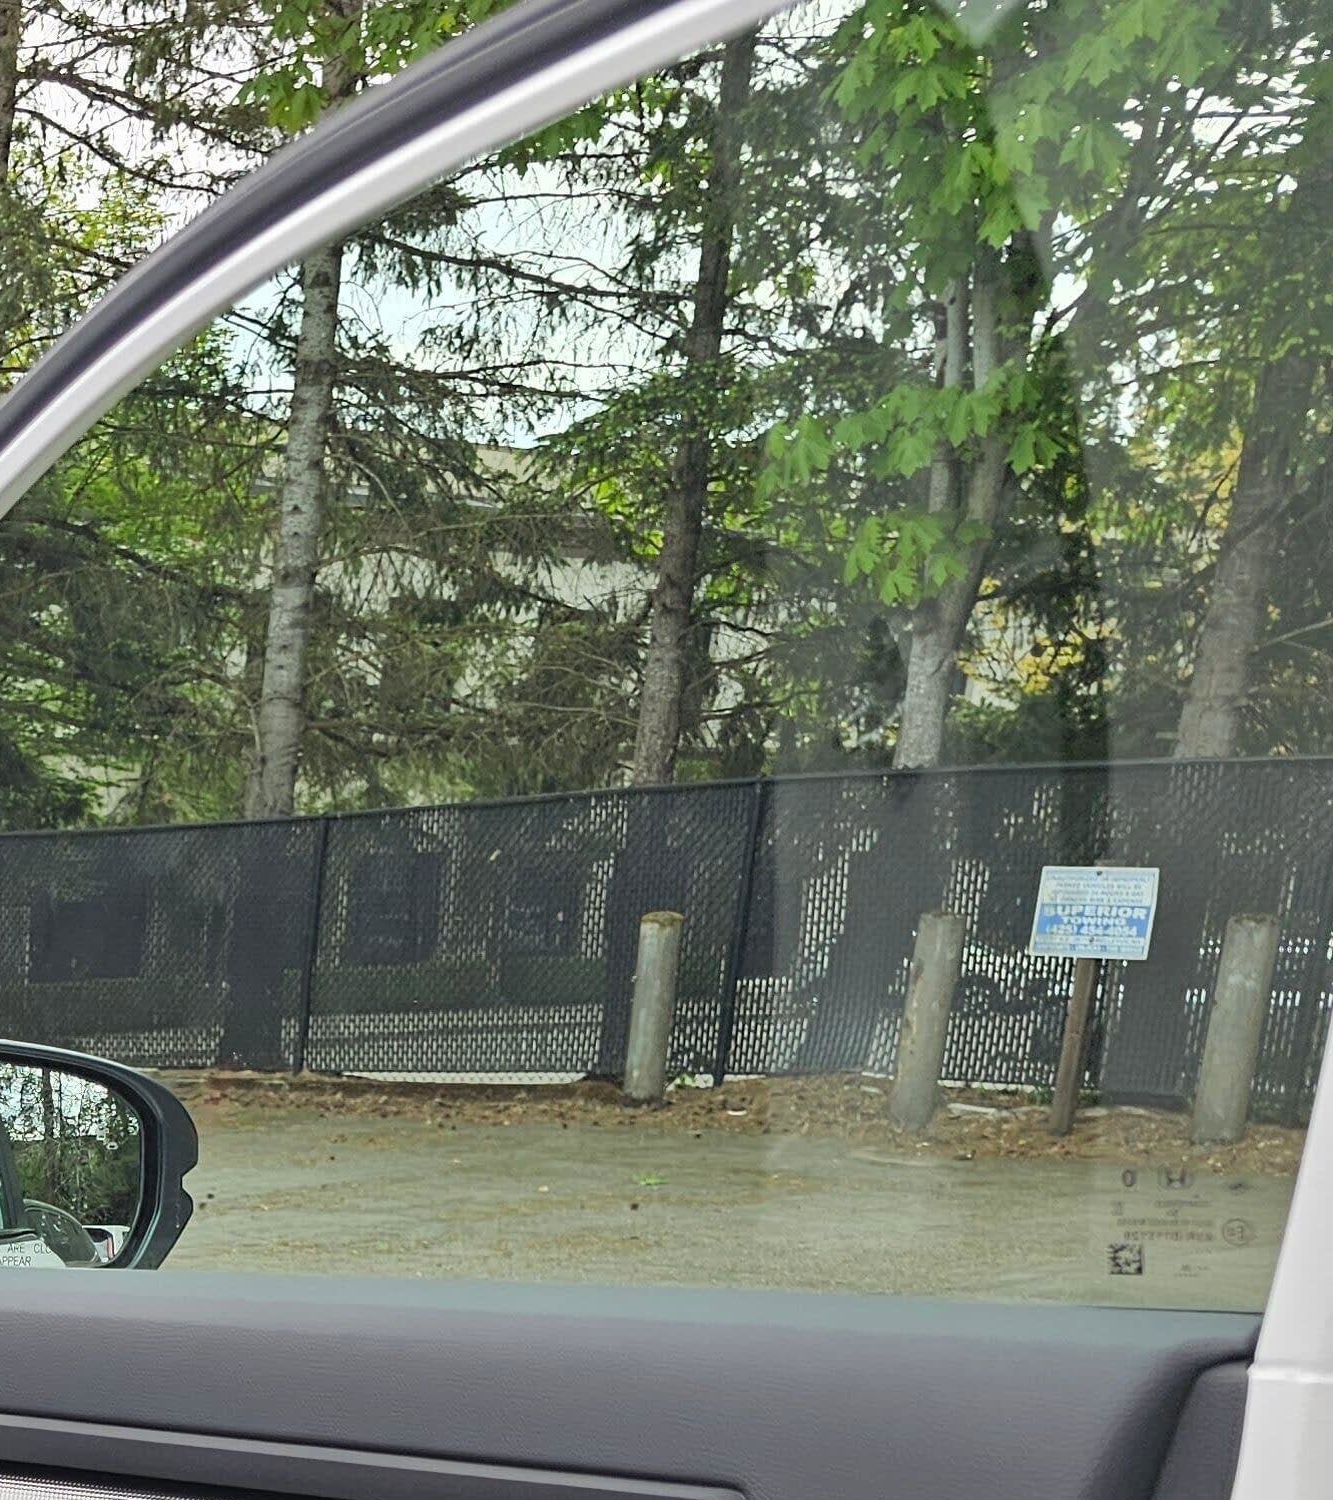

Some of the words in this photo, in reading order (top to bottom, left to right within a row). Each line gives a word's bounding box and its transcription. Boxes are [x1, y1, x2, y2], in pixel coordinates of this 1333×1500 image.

[1044, 905, 1148, 920] SUPERIOR
[1062, 916, 1127, 926] TOWING
[7, 1243, 25, 1253] ARE
